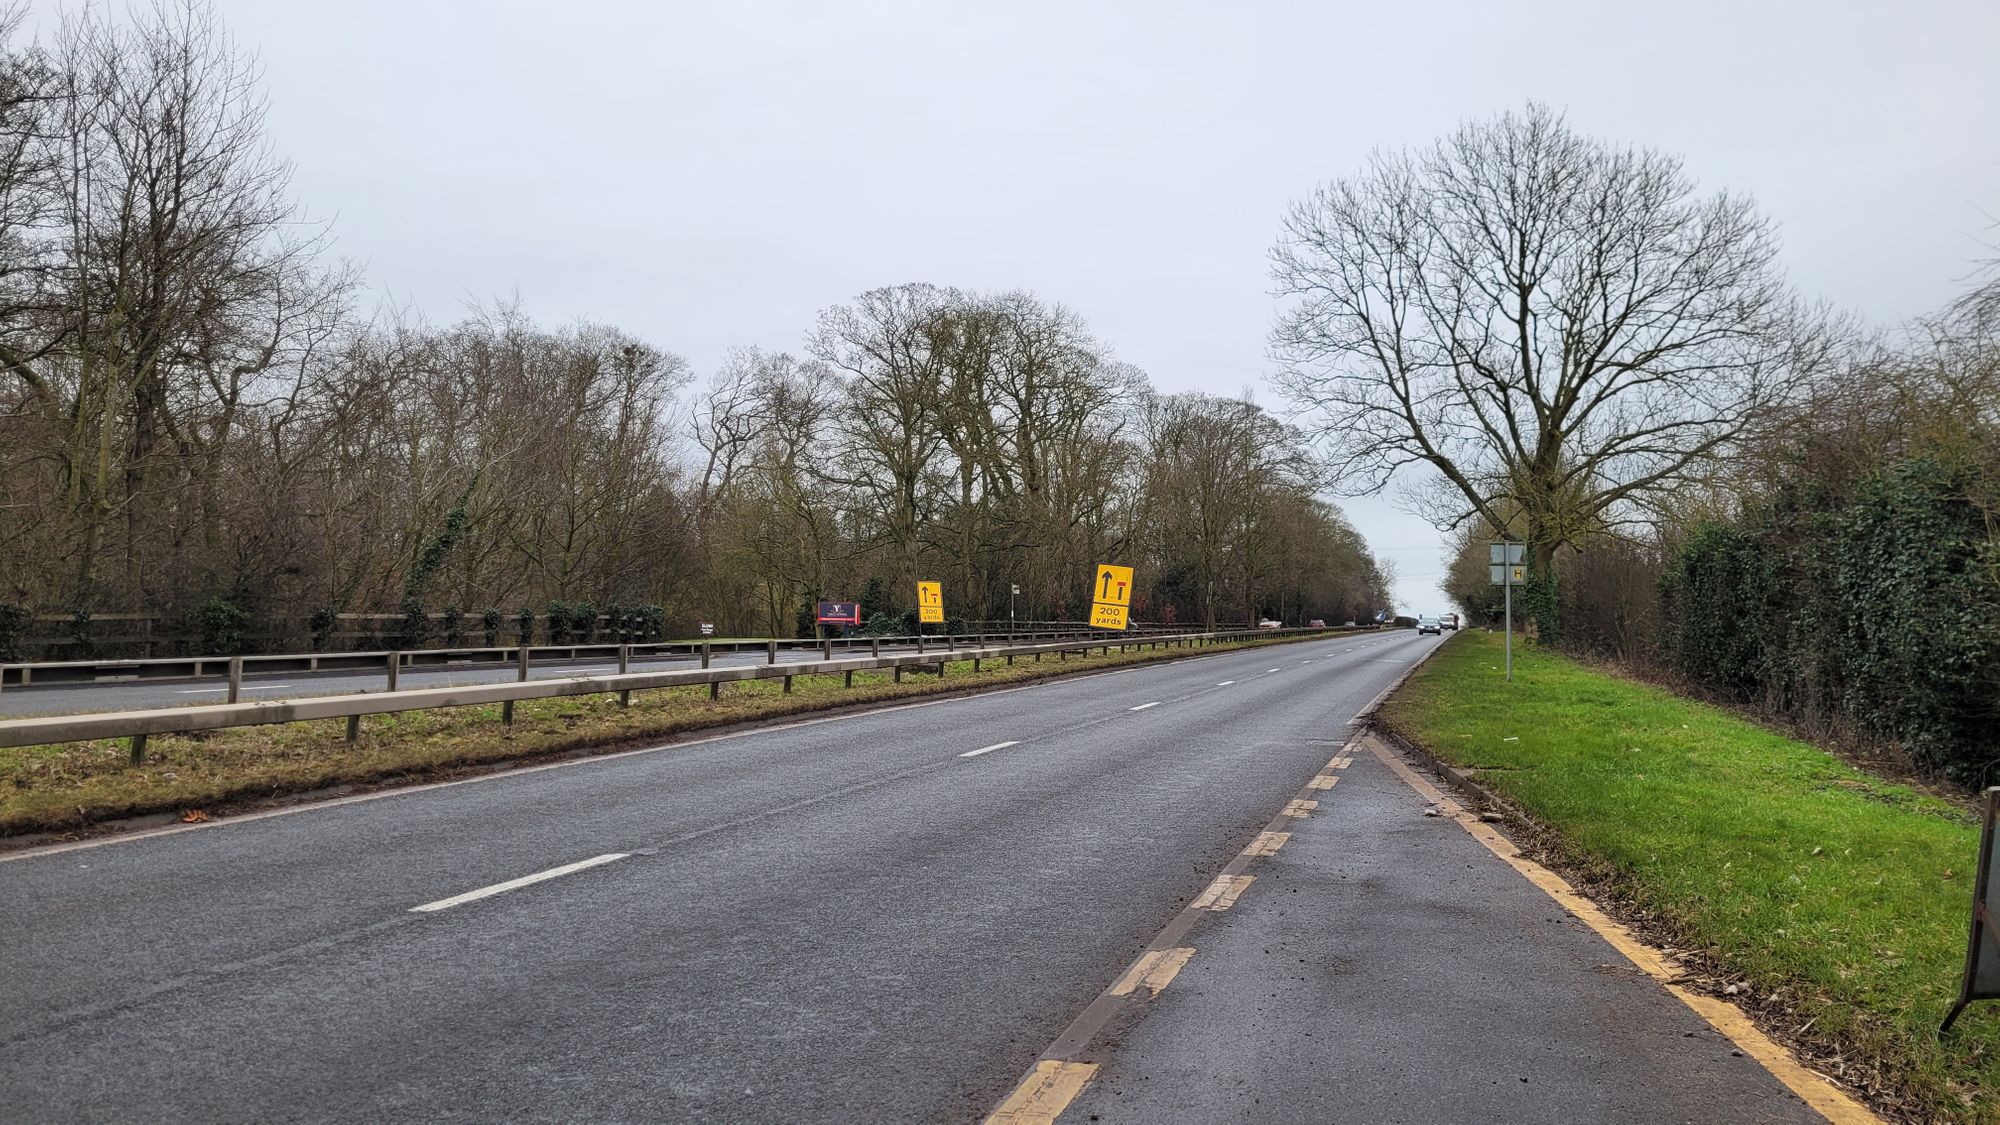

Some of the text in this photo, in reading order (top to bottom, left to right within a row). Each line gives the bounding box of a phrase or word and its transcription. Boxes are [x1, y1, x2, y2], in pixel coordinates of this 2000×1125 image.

[1514, 569, 1522, 579] H
[1100, 607, 1120, 616] 200
[1096, 617, 1121, 625] yards
